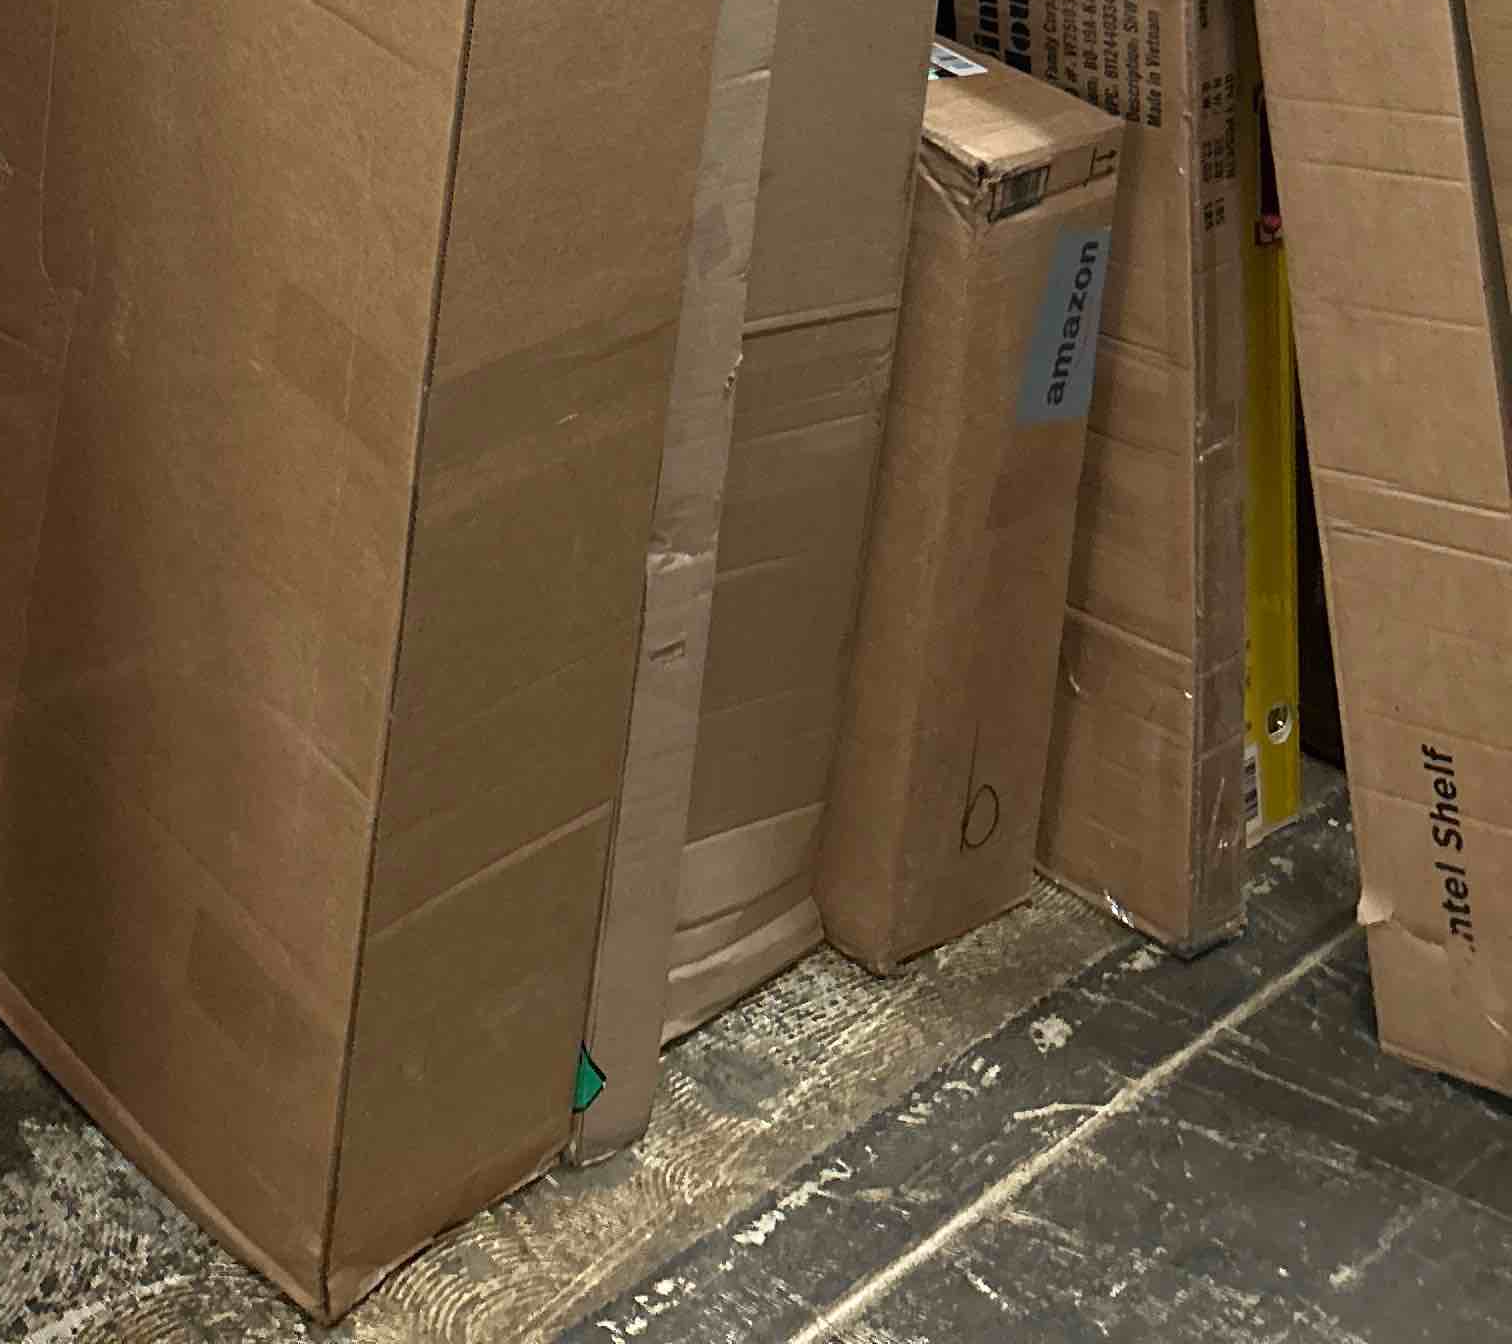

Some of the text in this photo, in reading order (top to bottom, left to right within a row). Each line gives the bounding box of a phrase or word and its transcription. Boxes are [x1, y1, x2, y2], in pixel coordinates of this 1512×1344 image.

[1145, 9, 1163, 128] Made in Vietnam
[1047, 241, 1099, 406] amazon
[1421, 743, 1464, 852] Shelf
